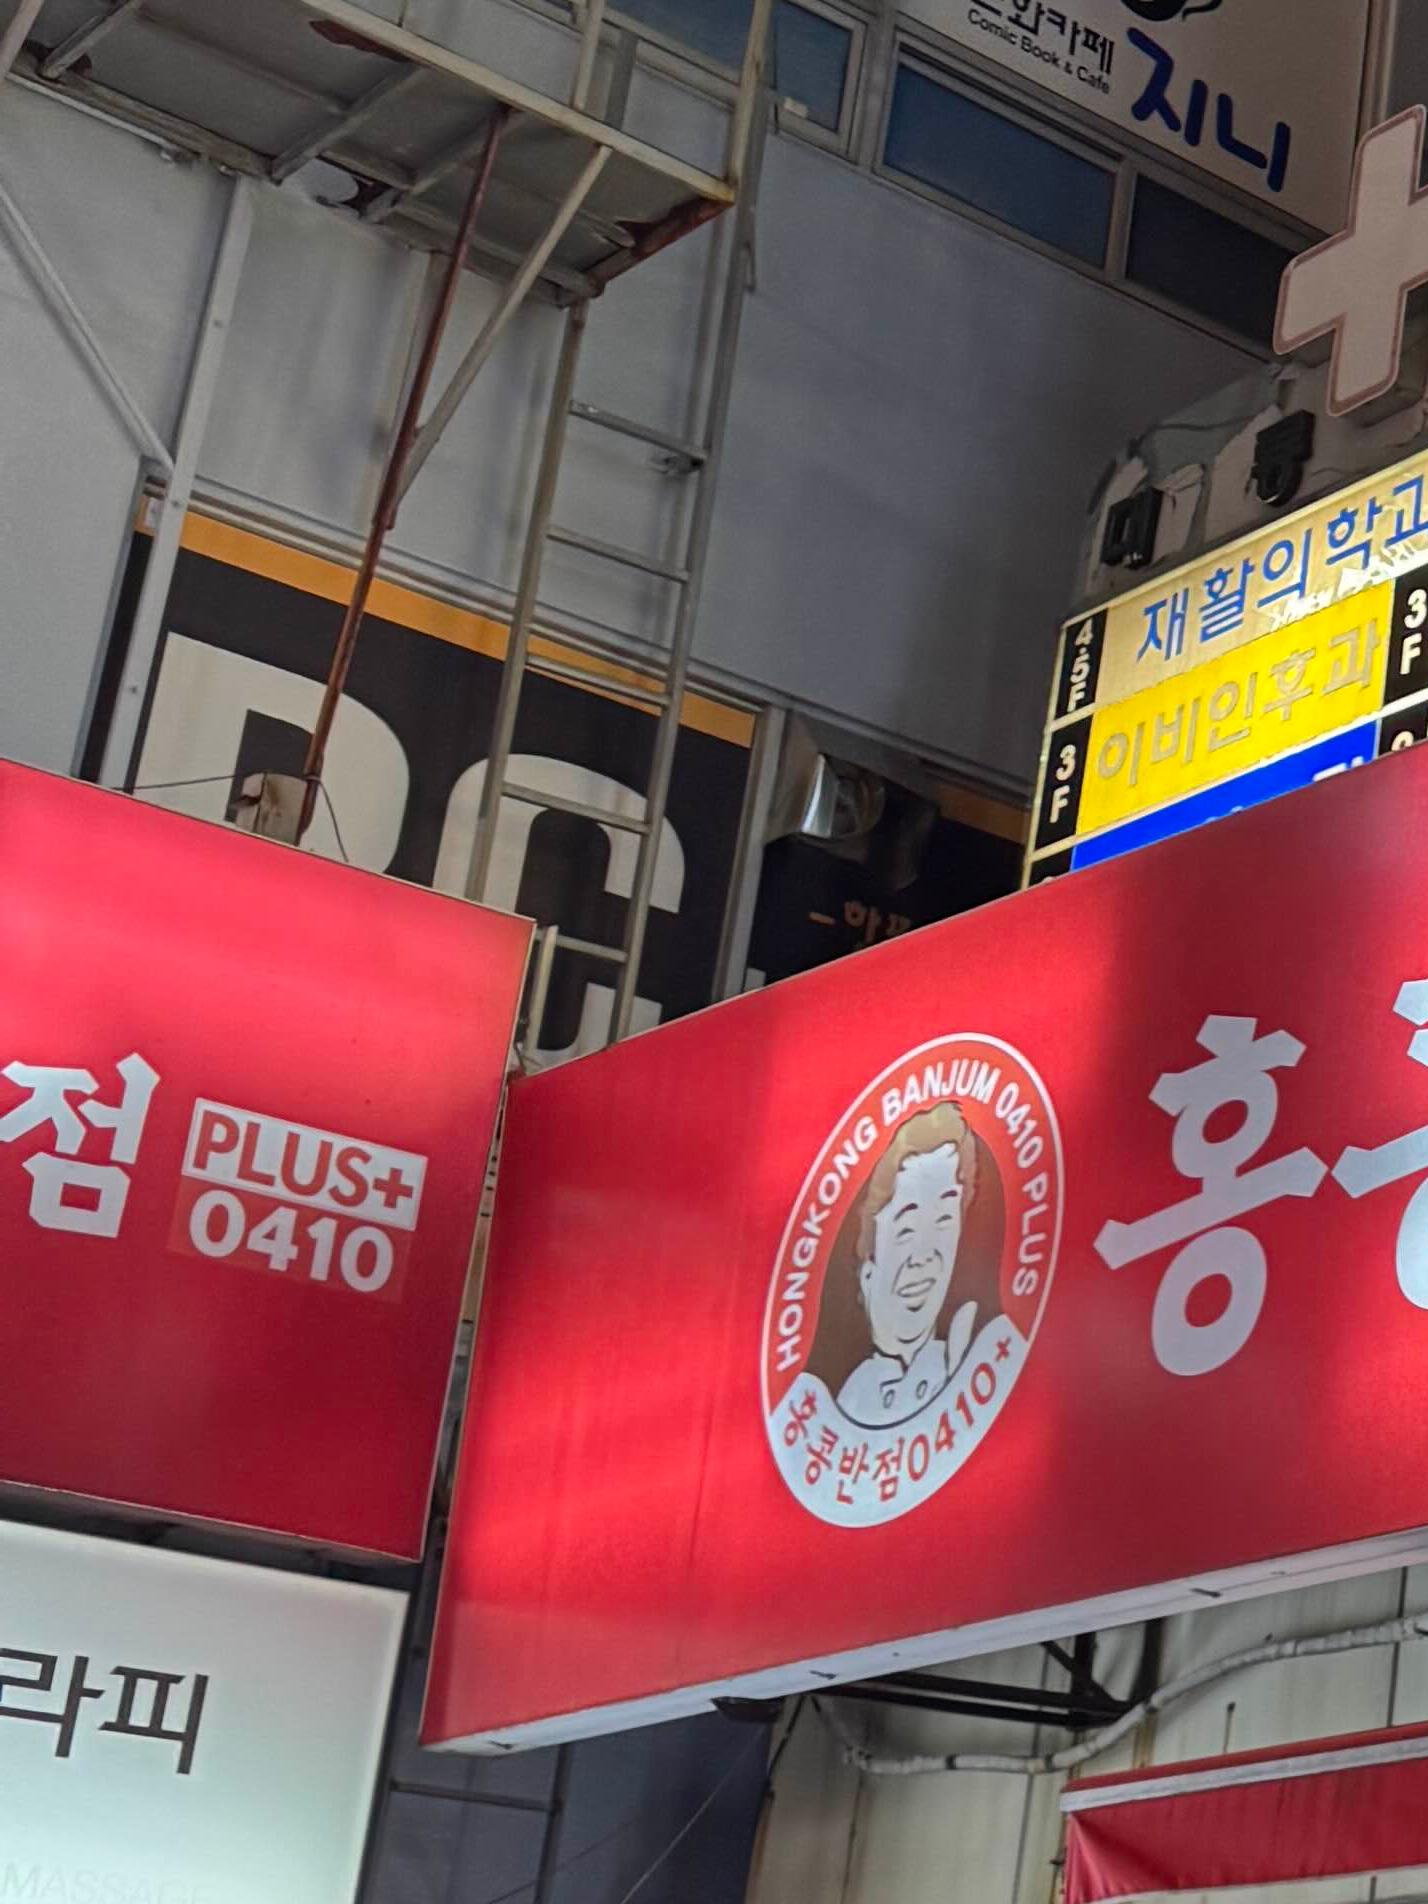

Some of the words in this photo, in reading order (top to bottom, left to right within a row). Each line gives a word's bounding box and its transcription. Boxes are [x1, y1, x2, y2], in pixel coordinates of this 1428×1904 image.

[968, 8, 1018, 47] Comic
[1020, 35, 1061, 68] Book
[1076, 65, 1111, 95] Cafe
[1126, 26, 1292, 193] 지니
[1400, 588, 1428, 676] 3F
[1098, 617, 1381, 786] 이비인후과
[1049, 743, 1077, 824] 3F
[881, 1058, 1003, 1123] BANJUM
[995, 1082, 1044, 1169] 0410
[0, 1052, 161, 1238] 점
[192, 1109, 415, 1208] PLUS+
[189, 1189, 394, 1293] 0410
[776, 1115, 880, 1373] HONGKONG
[1011, 1172, 1051, 1297] PLUS
[0, 1647, 209, 1775] 라피
